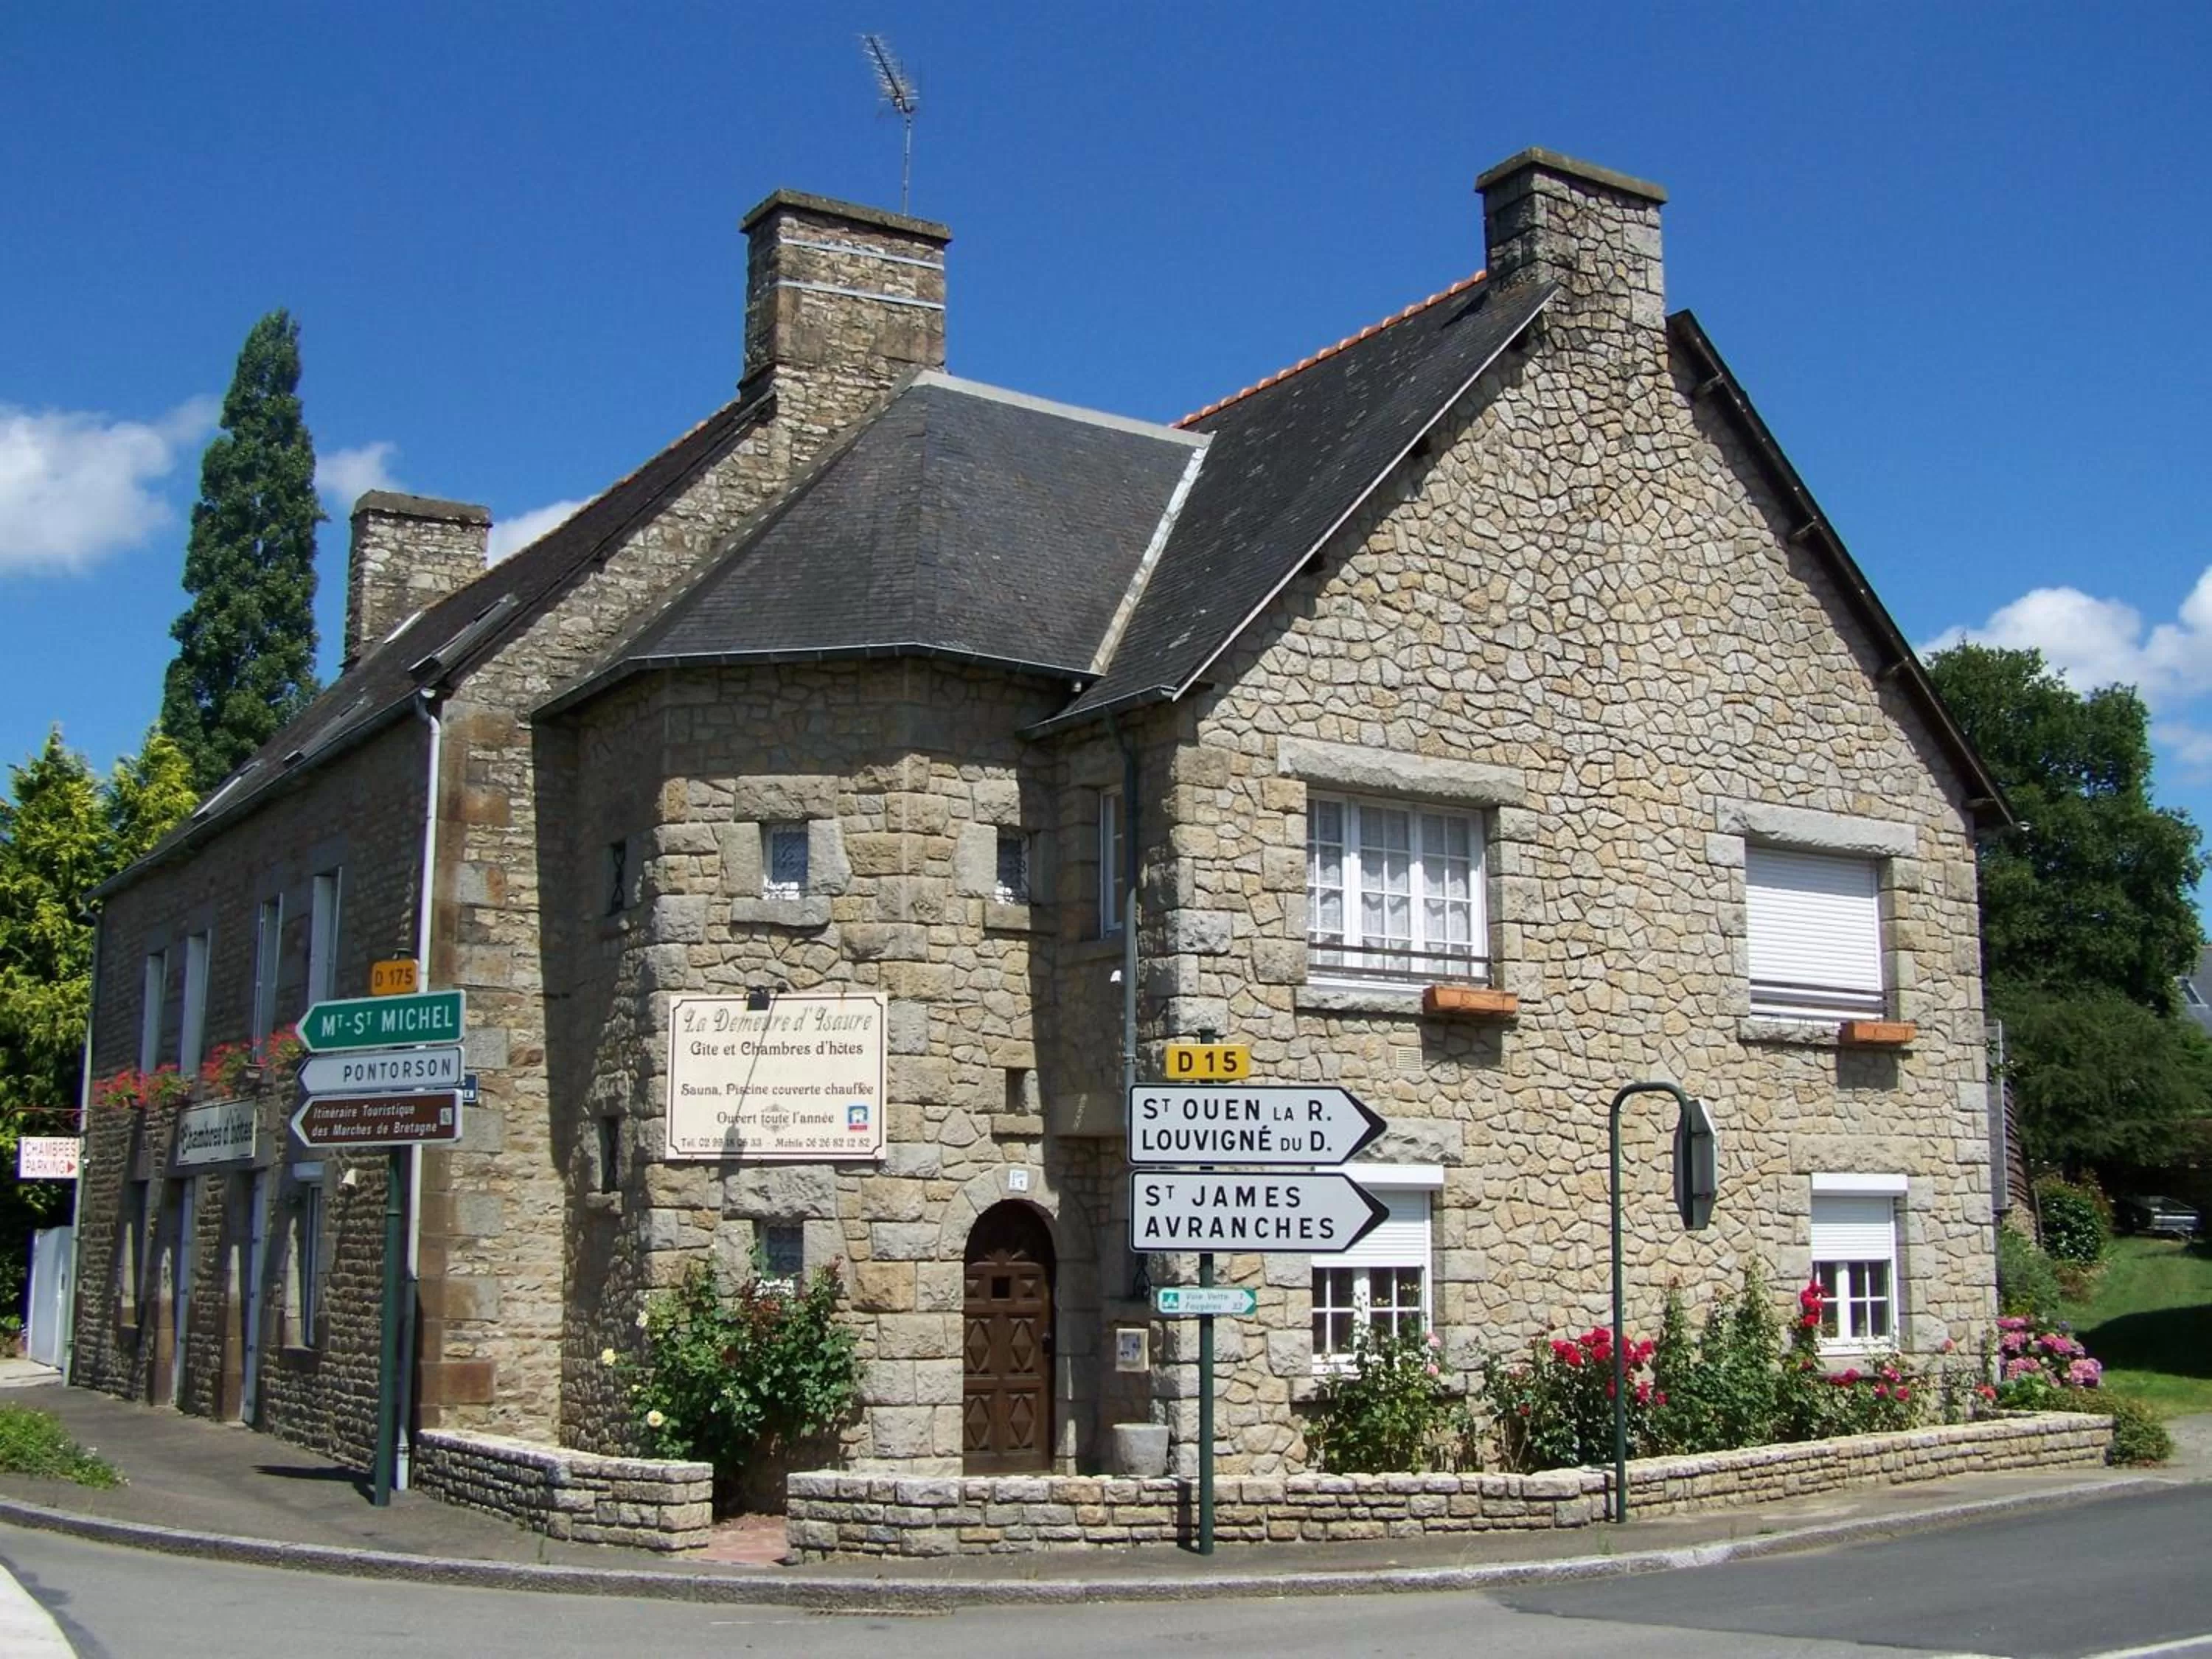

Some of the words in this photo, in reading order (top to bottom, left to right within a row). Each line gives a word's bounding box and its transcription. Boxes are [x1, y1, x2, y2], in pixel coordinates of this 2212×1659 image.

[375, 970, 383, 987] D
[389, 967, 414, 987] 175
[381, 1005, 453, 1033] MICHEL
[684, 1007, 707, 1032] La
[713, 1007, 791, 1033] Demeure
[723, 1043, 736, 1056] et
[740, 1040, 811, 1056] Chambres
[815, 1039, 864, 1055] d'hôtes
[343, 1058, 451, 1082] PONTORSON
[1178, 1051, 1193, 1072] D
[1205, 1051, 1238, 1072] 15
[681, 1083, 722, 1096] Sauna,
[726, 1082, 768, 1096] Piscine
[772, 1083, 821, 1096] couverte
[313, 1106, 358, 1119] Itinéraire
[362, 1104, 416, 1119] Touristique
[717, 1111, 757, 1125] Ouvert
[760, 1112, 788, 1125] toute
[793, 1111, 834, 1124] l'année
[1183, 1099, 1260, 1120] OUEN
[1273, 1107, 1294, 1121] LA
[1308, 1100, 1332, 1121] R.
[181, 1120, 223, 1155] Chambres
[311, 1126, 328, 1137] des
[333, 1123, 372, 1136] Marches
[377, 1122, 389, 1134] de
[394, 1121, 437, 1136] Bretagne
[1143, 1125, 1273, 1151] LOUVIGNÉ
[1280, 1138, 1302, 1151] DU
[1310, 1130, 1332, 1151] D.
[24, 1141, 76, 1158] CHAMBRES
[24, 1159, 66, 1175] PARKING
[1192, 1185, 1301, 1208] JAMES
[1144, 1216, 1335, 1239] AVRANCHES
